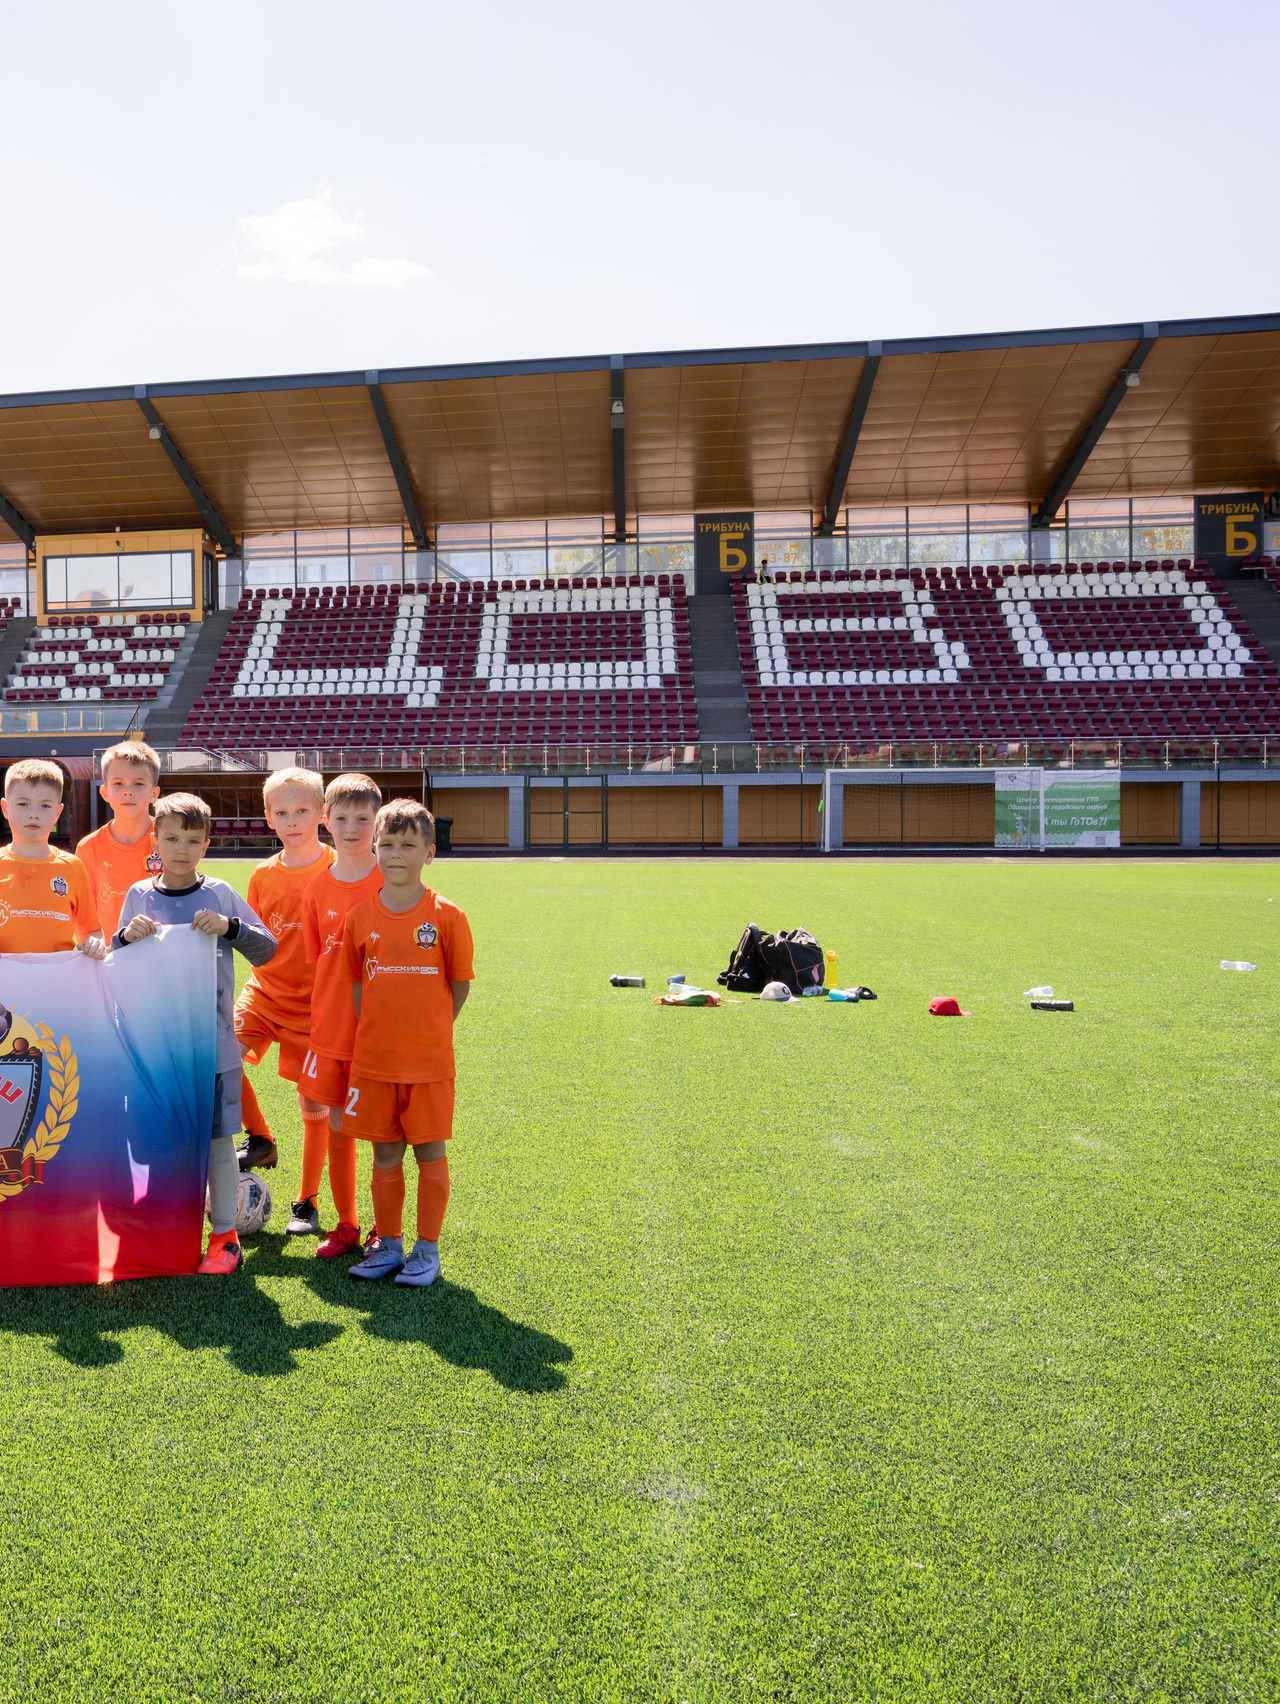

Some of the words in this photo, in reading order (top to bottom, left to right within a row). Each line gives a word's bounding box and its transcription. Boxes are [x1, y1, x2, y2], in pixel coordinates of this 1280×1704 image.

[1200, 502, 1260, 515] ТРИБУНА
[698, 522, 751, 533] ТРИБУНА
[1226, 514, 1257, 557] Б
[720, 532, 747, 572] Б
[1150, 539, 1183, 551] 1-63
[345, 1086, 360, 1117] 2
